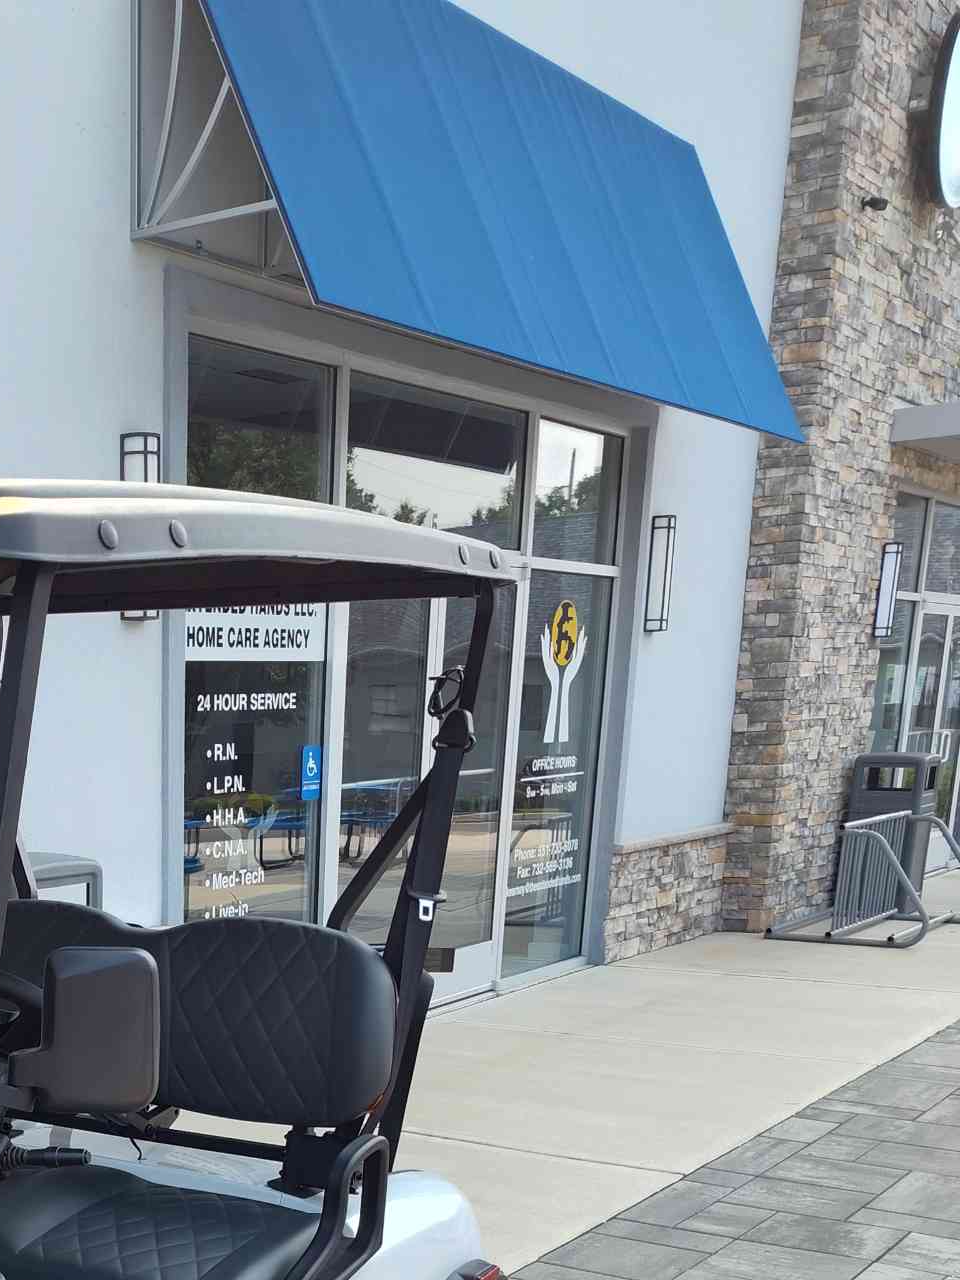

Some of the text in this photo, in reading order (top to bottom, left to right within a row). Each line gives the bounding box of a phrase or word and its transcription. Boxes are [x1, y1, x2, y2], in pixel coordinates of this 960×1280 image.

[187, 626, 310, 649] HOME CARE AGENCY
[197, 692, 297, 712] 24 HOUR SERVICE
[214, 743, 239, 761] R.N.
[532, 755, 577, 771] OFFICE HOURS
[213, 775, 246, 794] L.P.N.
[213, 806, 248, 826] H.H.A.
[212, 839, 248, 858] C.N.A.
[212, 866, 265, 890] Med-Tech
